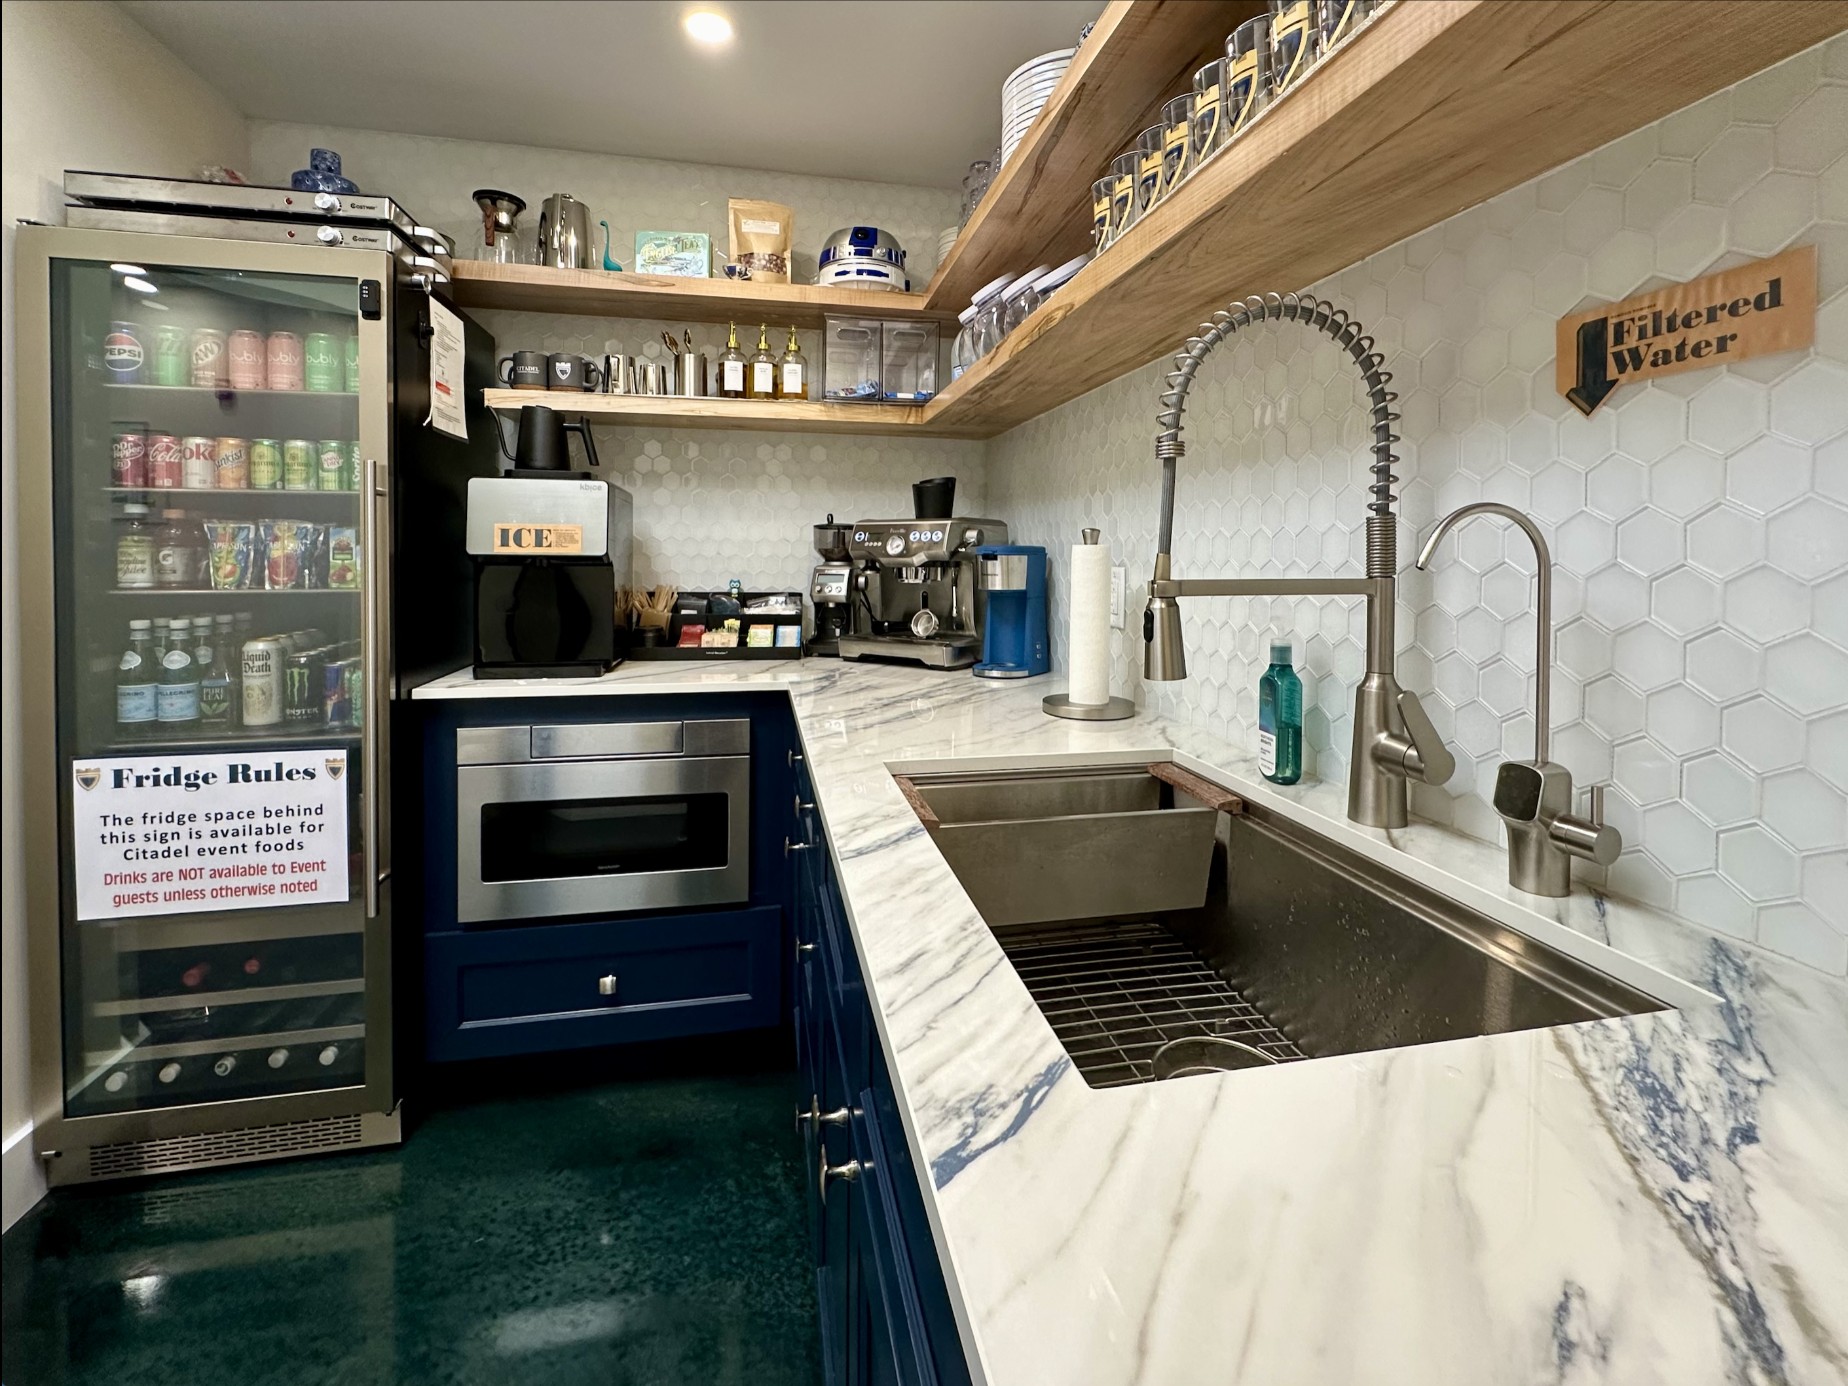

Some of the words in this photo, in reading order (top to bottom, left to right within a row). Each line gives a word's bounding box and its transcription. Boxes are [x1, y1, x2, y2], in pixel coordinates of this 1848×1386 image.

[1610, 277, 1785, 348] Filtered
[104, 347, 141, 359] PEPSI
[306, 352, 338, 367] bubly
[1610, 332, 1738, 376] Water
[498, 527, 552, 548] ICE
[242, 650, 271, 664] Liquid
[243, 662, 271, 674] Death
[111, 766, 218, 792] Fridge
[227, 762, 317, 784] Rules
[100, 814, 134, 827] The
[142, 811, 197, 826] fridge
[204, 809, 256, 823] space
[263, 803, 324, 818] behind
[100, 832, 136, 845] this
[144, 829, 181, 845] sign
[189, 828, 202, 840] is
[210, 823, 292, 839] available
[300, 821, 325, 833] for
[123, 845, 189, 861] Citadel
[197, 843, 248, 857] event
[255, 839, 305, 853] foods
[104, 870, 147, 886] Drinks
[152, 870, 174, 883] are
[178, 868, 206, 882] NOT
[209, 863, 267, 880] available
[272, 862, 286, 875] to
[290, 860, 326, 874] Event
[113, 890, 159, 907] guests
[163, 887, 206, 903] unless
[210, 883, 276, 899] otherwise
[280, 879, 318, 893] noted
